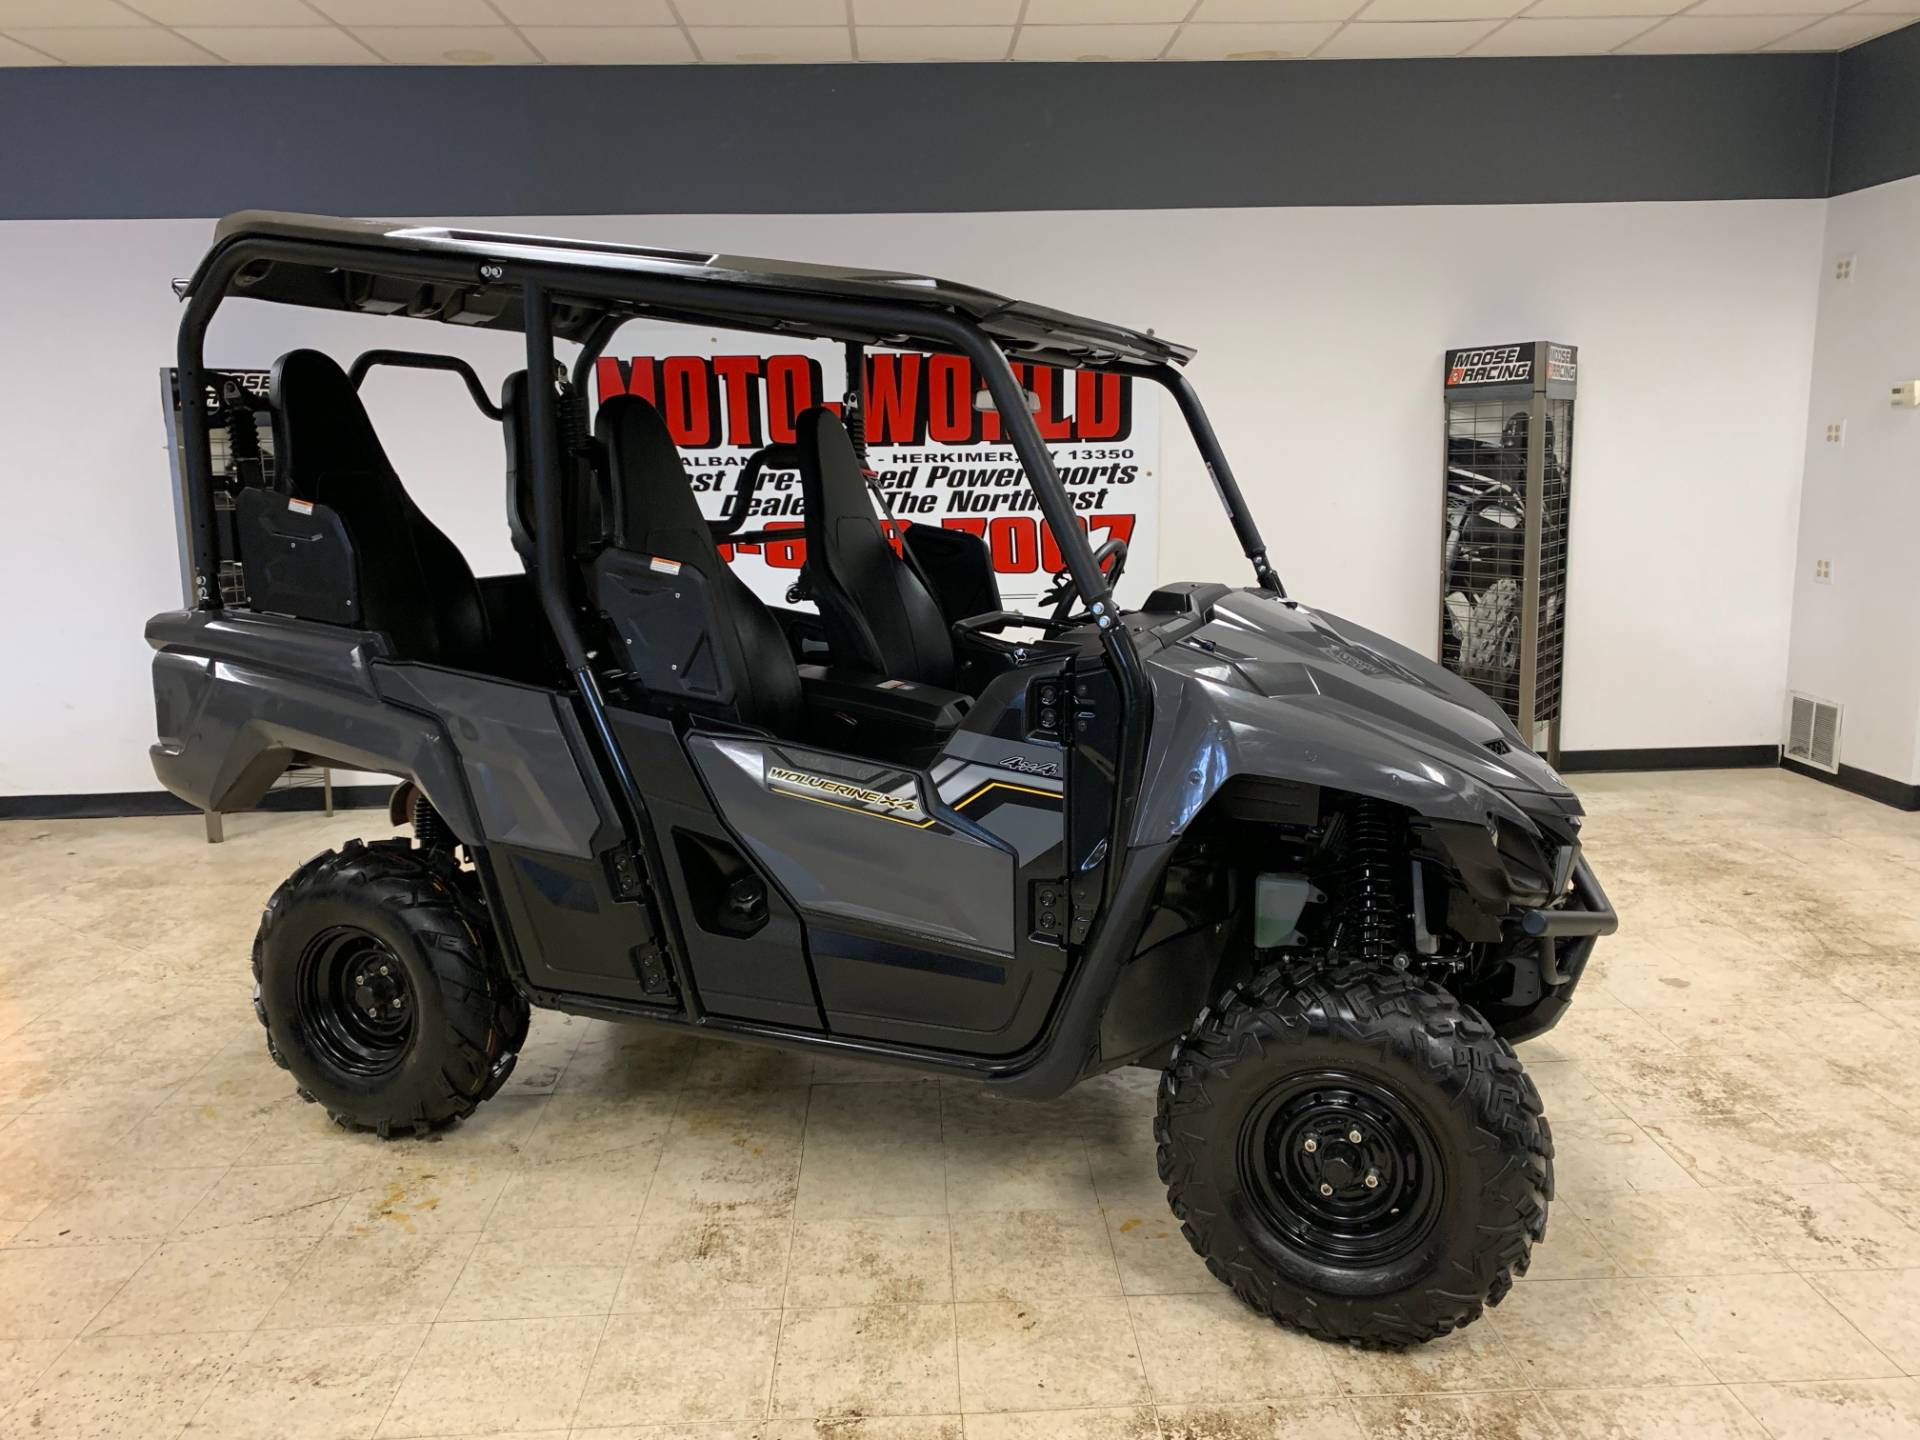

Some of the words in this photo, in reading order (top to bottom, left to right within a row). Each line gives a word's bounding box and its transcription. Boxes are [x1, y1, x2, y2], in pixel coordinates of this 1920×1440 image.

[1453, 347, 1520, 369] MOOSE
[1460, 361, 1531, 383] RACING
[892, 452, 1020, 464] HERKIMER,
[1068, 449, 1135, 460] 13350
[883, 491, 938, 514] The
[1000, 756, 1057, 776] 4x4
[768, 766, 879, 803] WOLVERINE
[879, 793, 918, 813] X4
